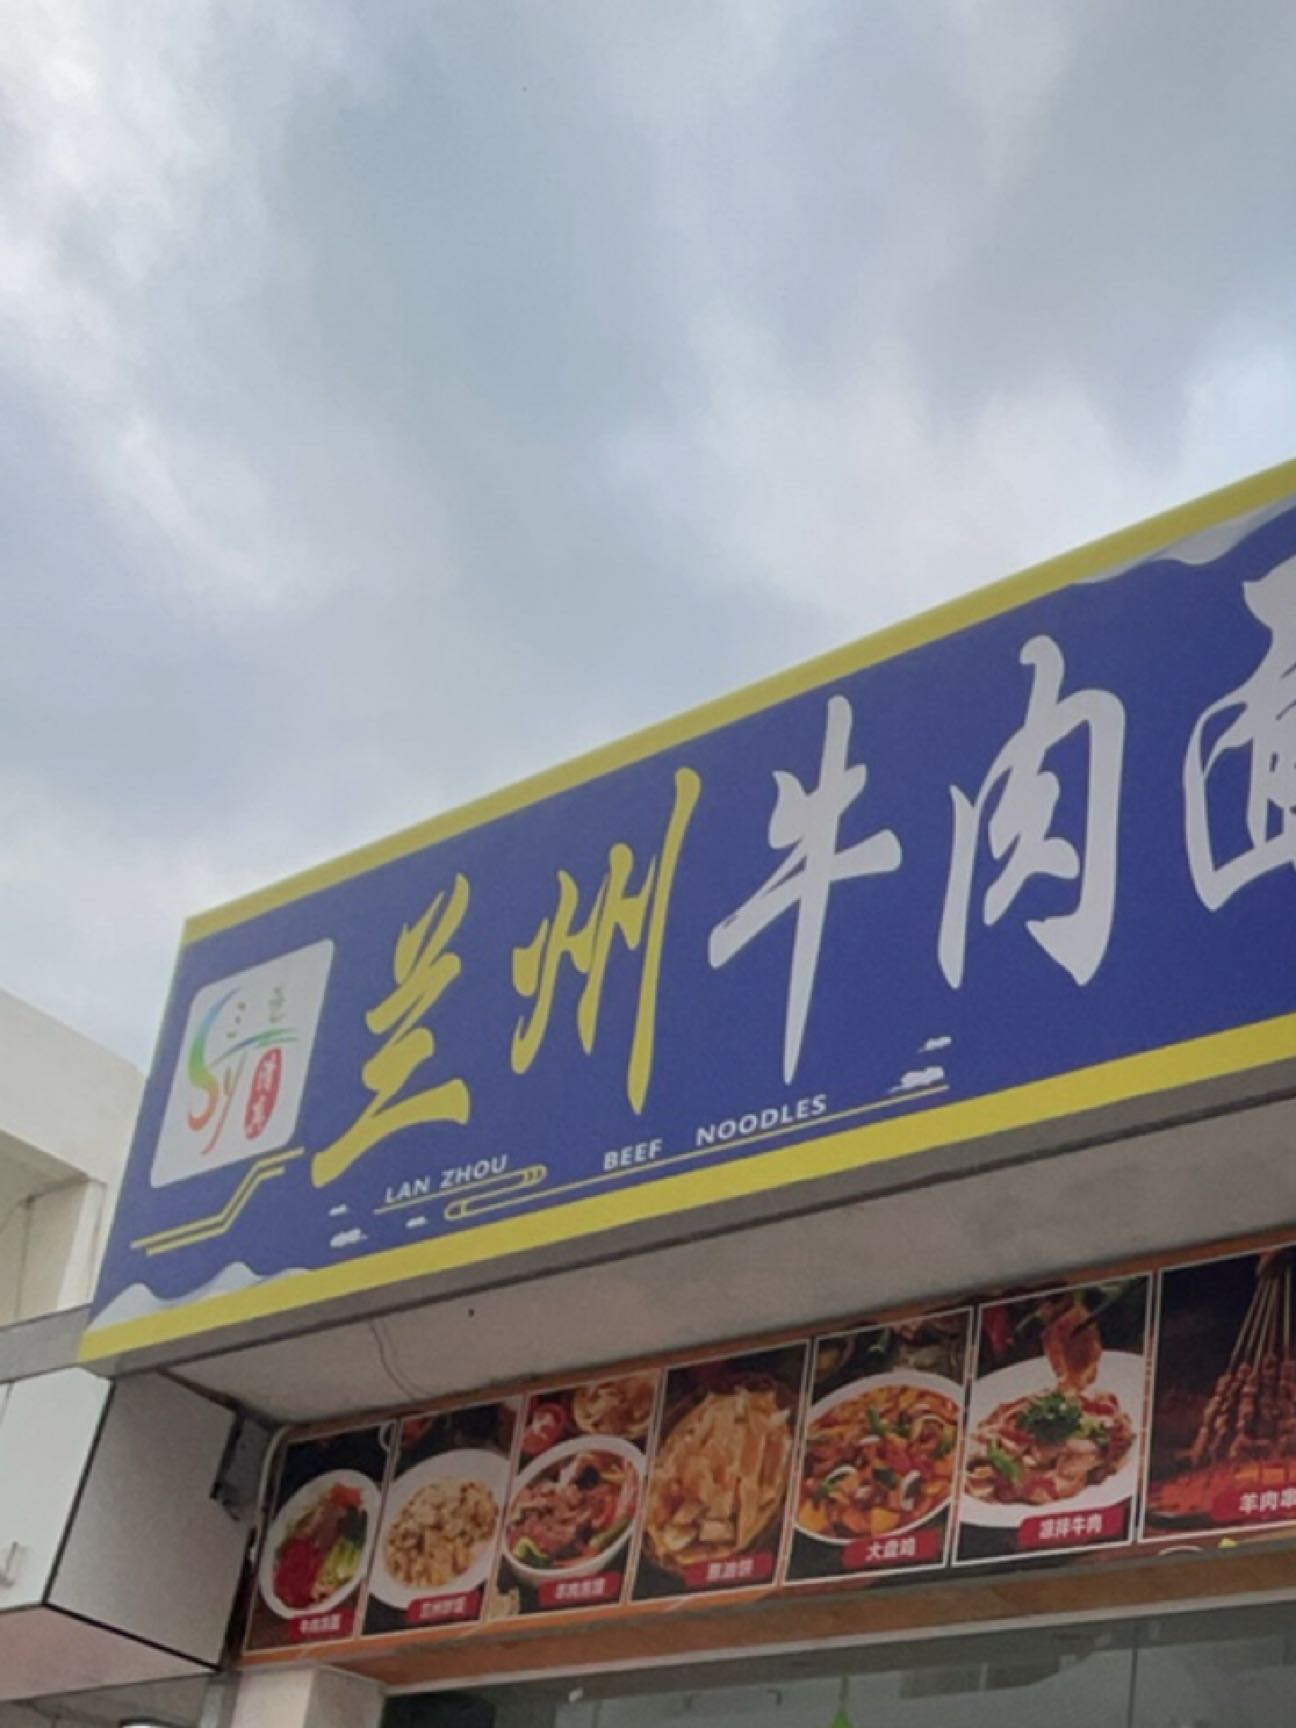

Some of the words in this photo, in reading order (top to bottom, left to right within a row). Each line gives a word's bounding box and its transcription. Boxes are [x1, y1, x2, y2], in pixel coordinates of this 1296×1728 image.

[384, 1174, 431, 1205] LAN
[440, 1153, 509, 1190] ZHOU
[603, 1138, 664, 1172] BEEF
[695, 1093, 829, 1147] NOODLES
[865, 1535, 916, 1562] 大盘鸡
